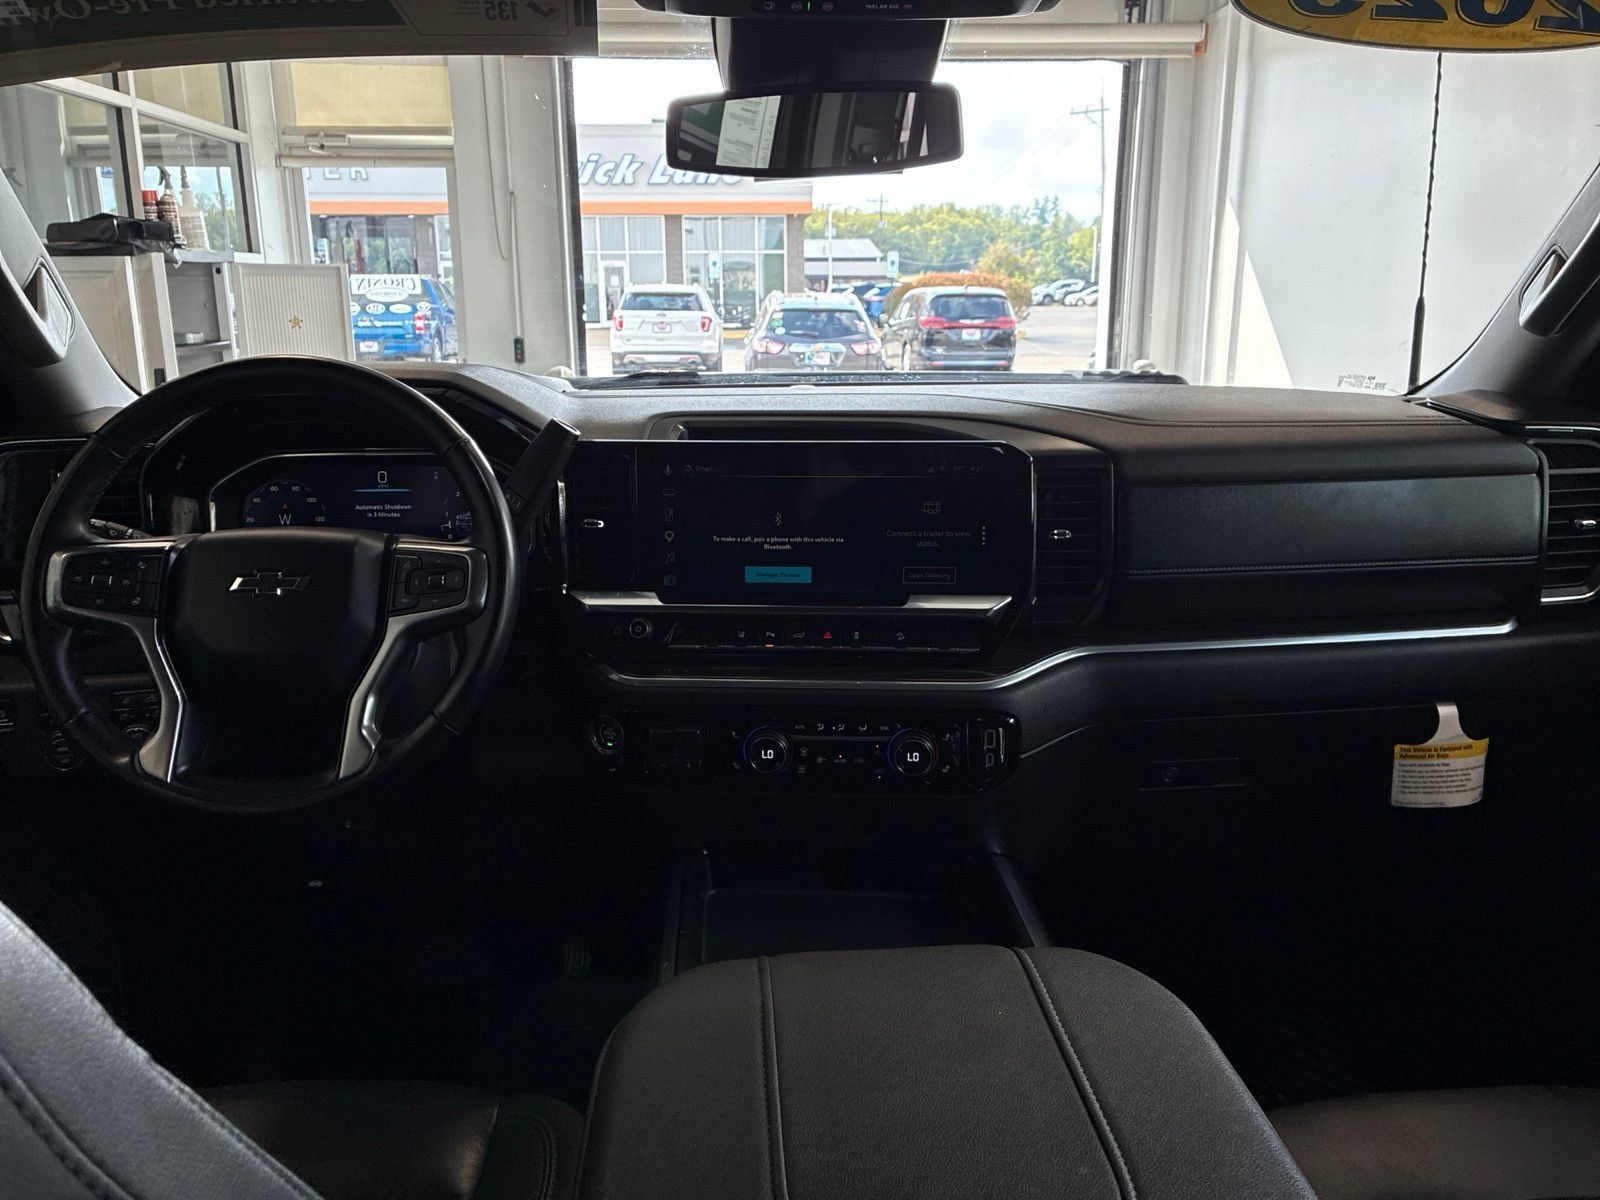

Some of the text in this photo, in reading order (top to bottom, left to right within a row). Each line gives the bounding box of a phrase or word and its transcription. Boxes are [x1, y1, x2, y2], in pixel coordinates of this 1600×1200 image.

[378, 471, 387, 484] 0
[279, 513, 291, 526] W
[886, 529, 917, 537] Connect
[924, 529, 944, 537] trailer
[761, 750, 774, 759] LO
[907, 752, 919, 762] LO
